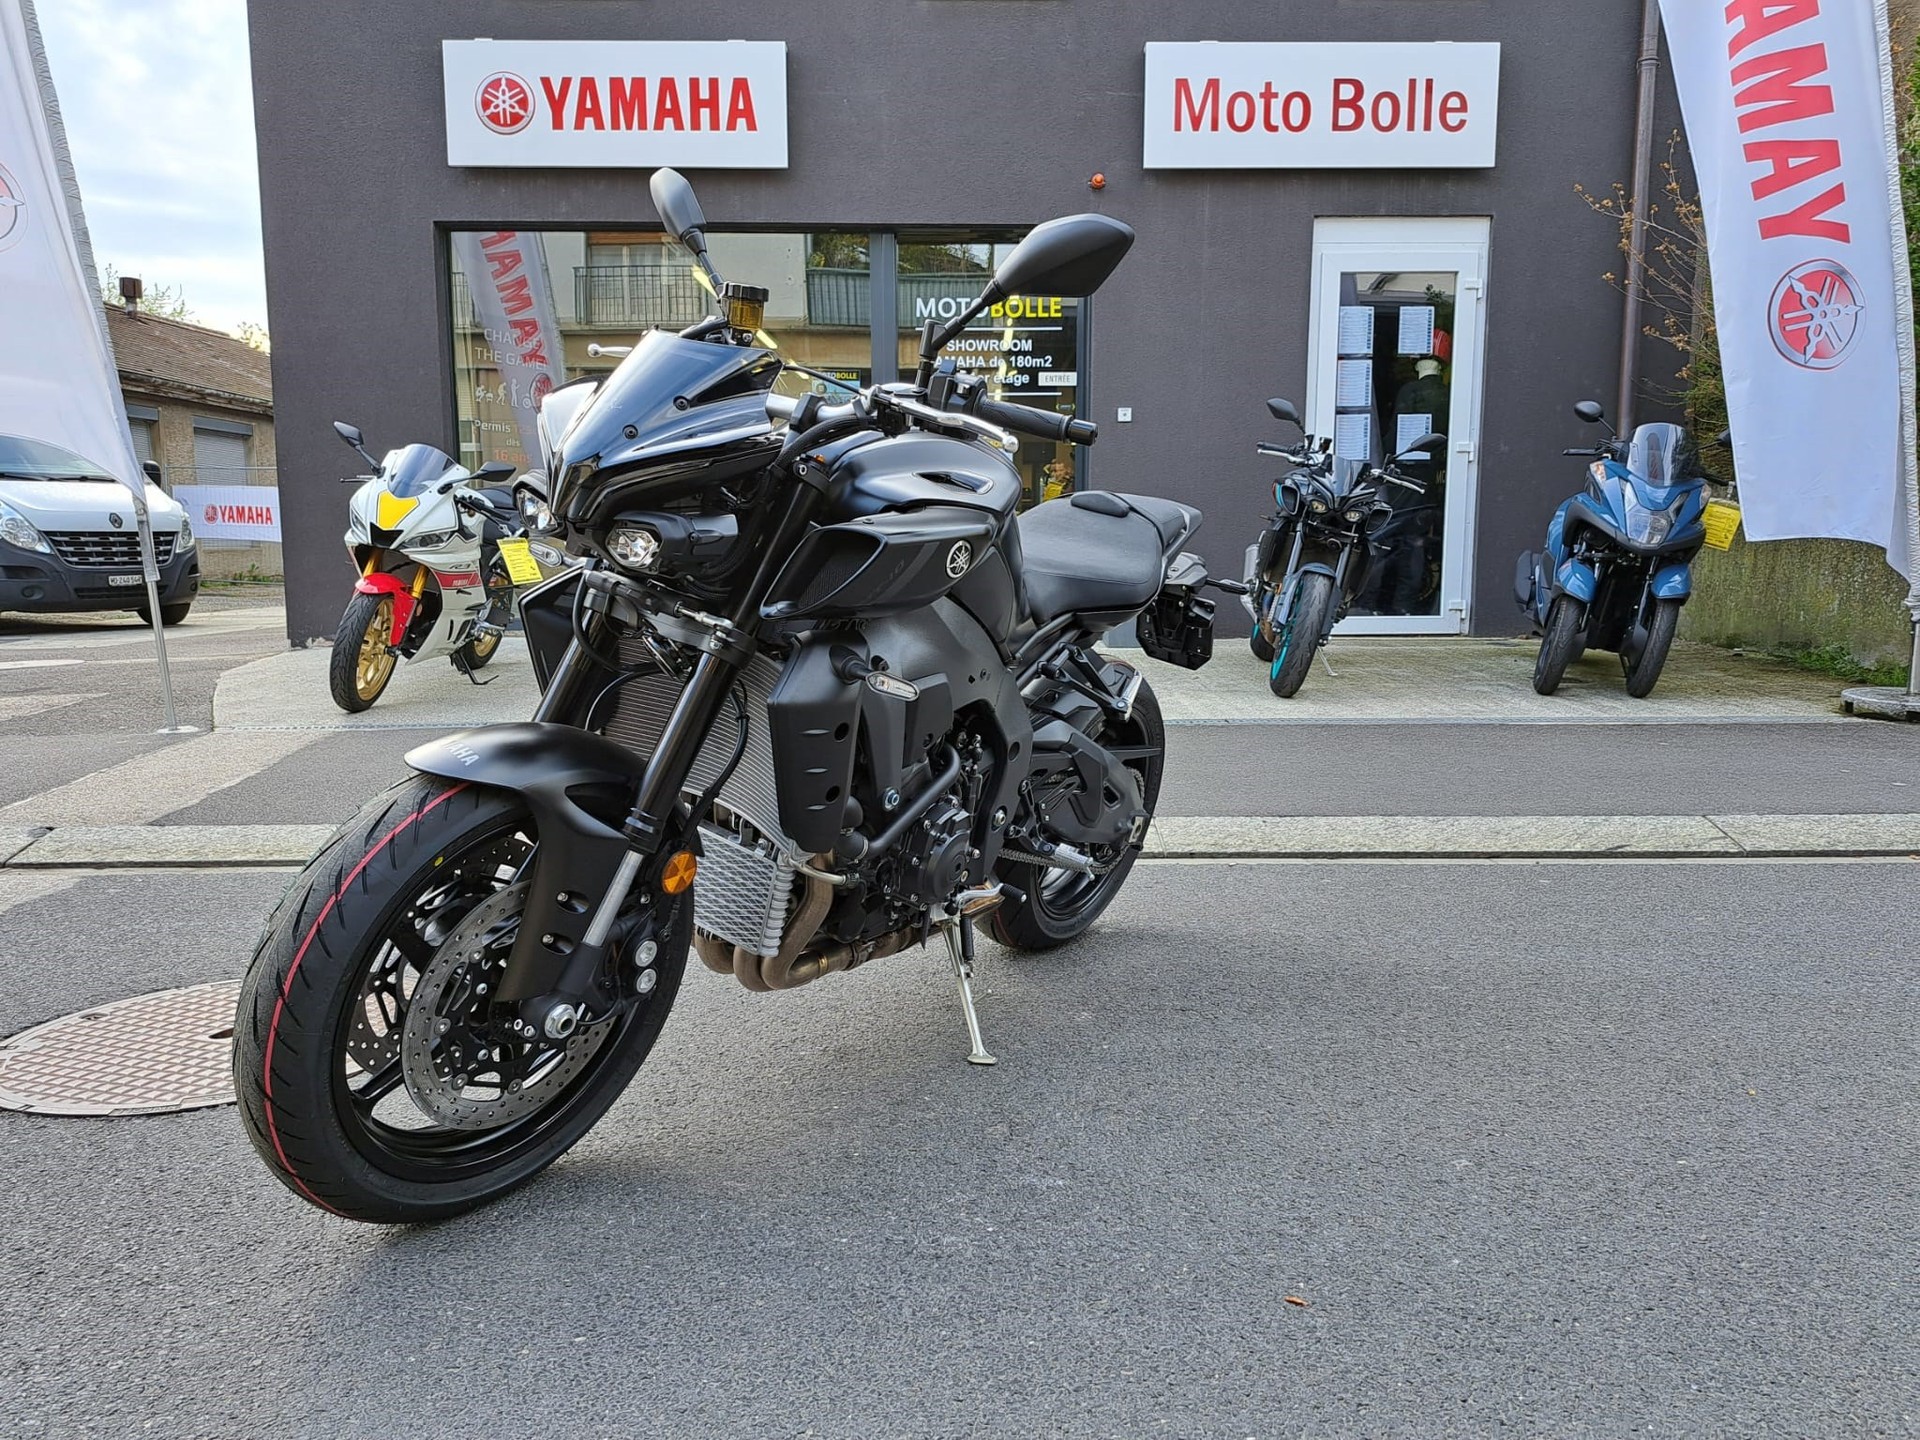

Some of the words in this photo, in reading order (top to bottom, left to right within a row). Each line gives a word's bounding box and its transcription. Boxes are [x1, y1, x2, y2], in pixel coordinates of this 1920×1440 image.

[540, 77, 758, 131] YAMAHA
[1173, 78, 1312, 133] Moto
[1331, 78, 1469, 133] Bolle
[946, 339, 1033, 352] SHOWROOM
[475, 347, 502, 363] THE
[1011, 355, 1053, 368] 180m2
[1044, 374, 1071, 384] ENTRÉE
[474, 419, 511, 433] Permis
[494, 449, 508, 461] 16
[219, 505, 274, 526] YAMAHA
